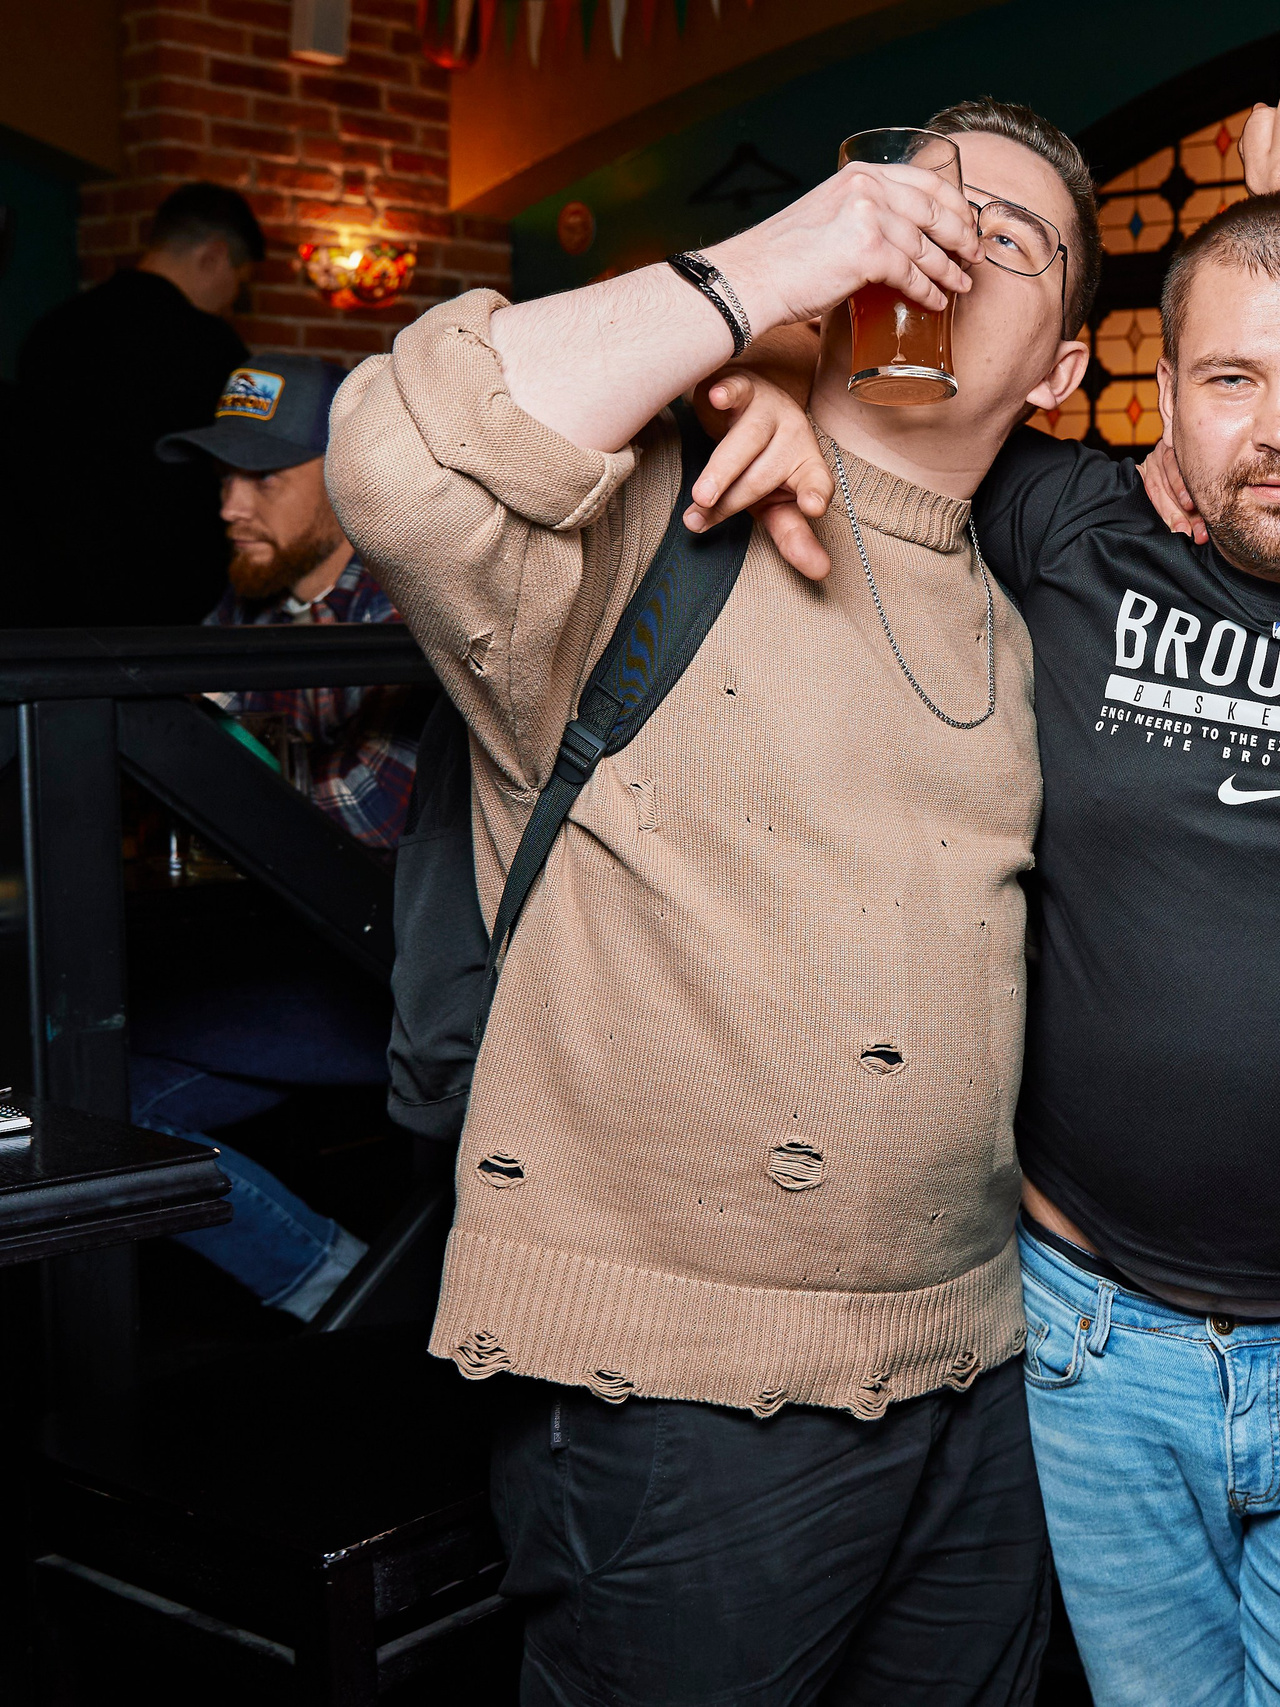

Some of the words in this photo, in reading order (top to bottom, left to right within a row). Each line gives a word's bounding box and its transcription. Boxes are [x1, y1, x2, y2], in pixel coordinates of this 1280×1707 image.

[1095, 721, 1120, 735] OF
[1147, 732, 1191, 751] THE
[1101, 706, 1192, 735] ENGINEERED
[1202, 727, 1219, 740] TO
[1230, 731, 1258, 747] THE
